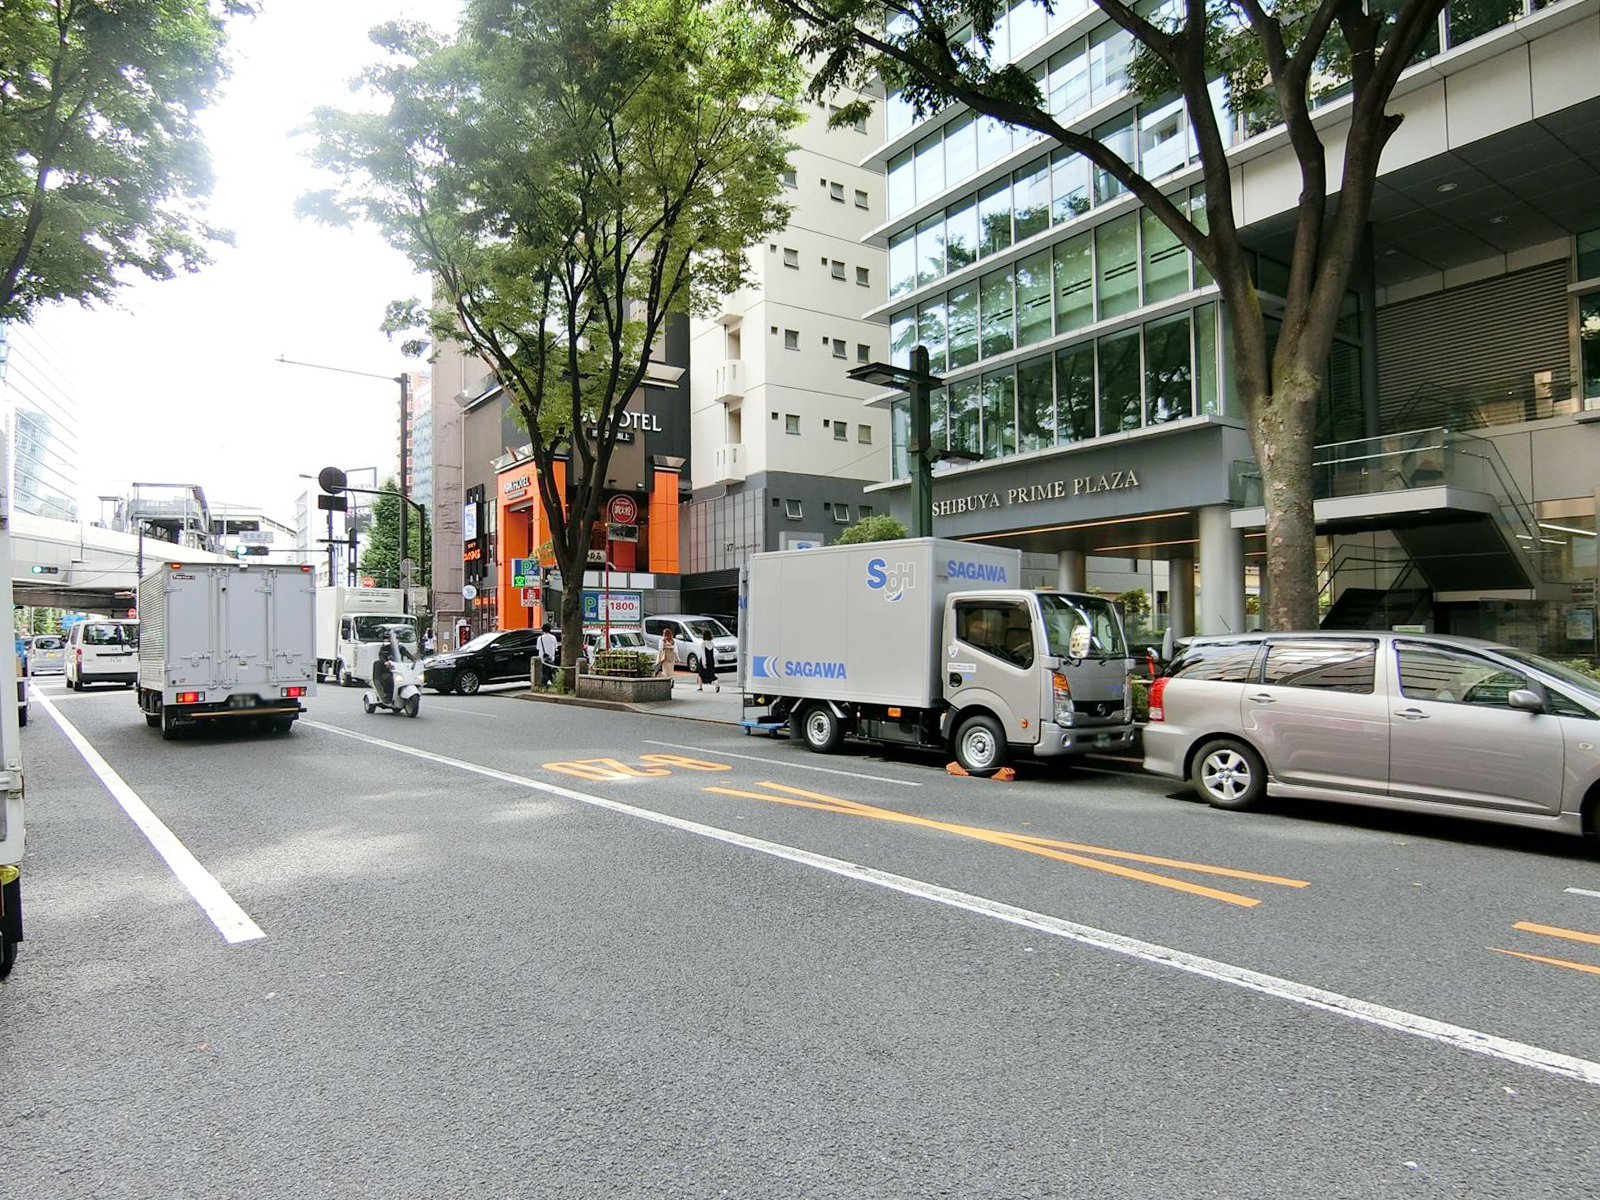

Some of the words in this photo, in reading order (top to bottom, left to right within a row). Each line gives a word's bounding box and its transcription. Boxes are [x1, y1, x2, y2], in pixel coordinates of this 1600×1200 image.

[931, 492, 1000, 517] SHIBUYA
[1008, 480, 1066, 505] PRIME
[1074, 469, 1140, 496] PLAZA
[947, 560, 1007, 583] SAGAWA
[784, 660, 848, 680] SAGAWA
